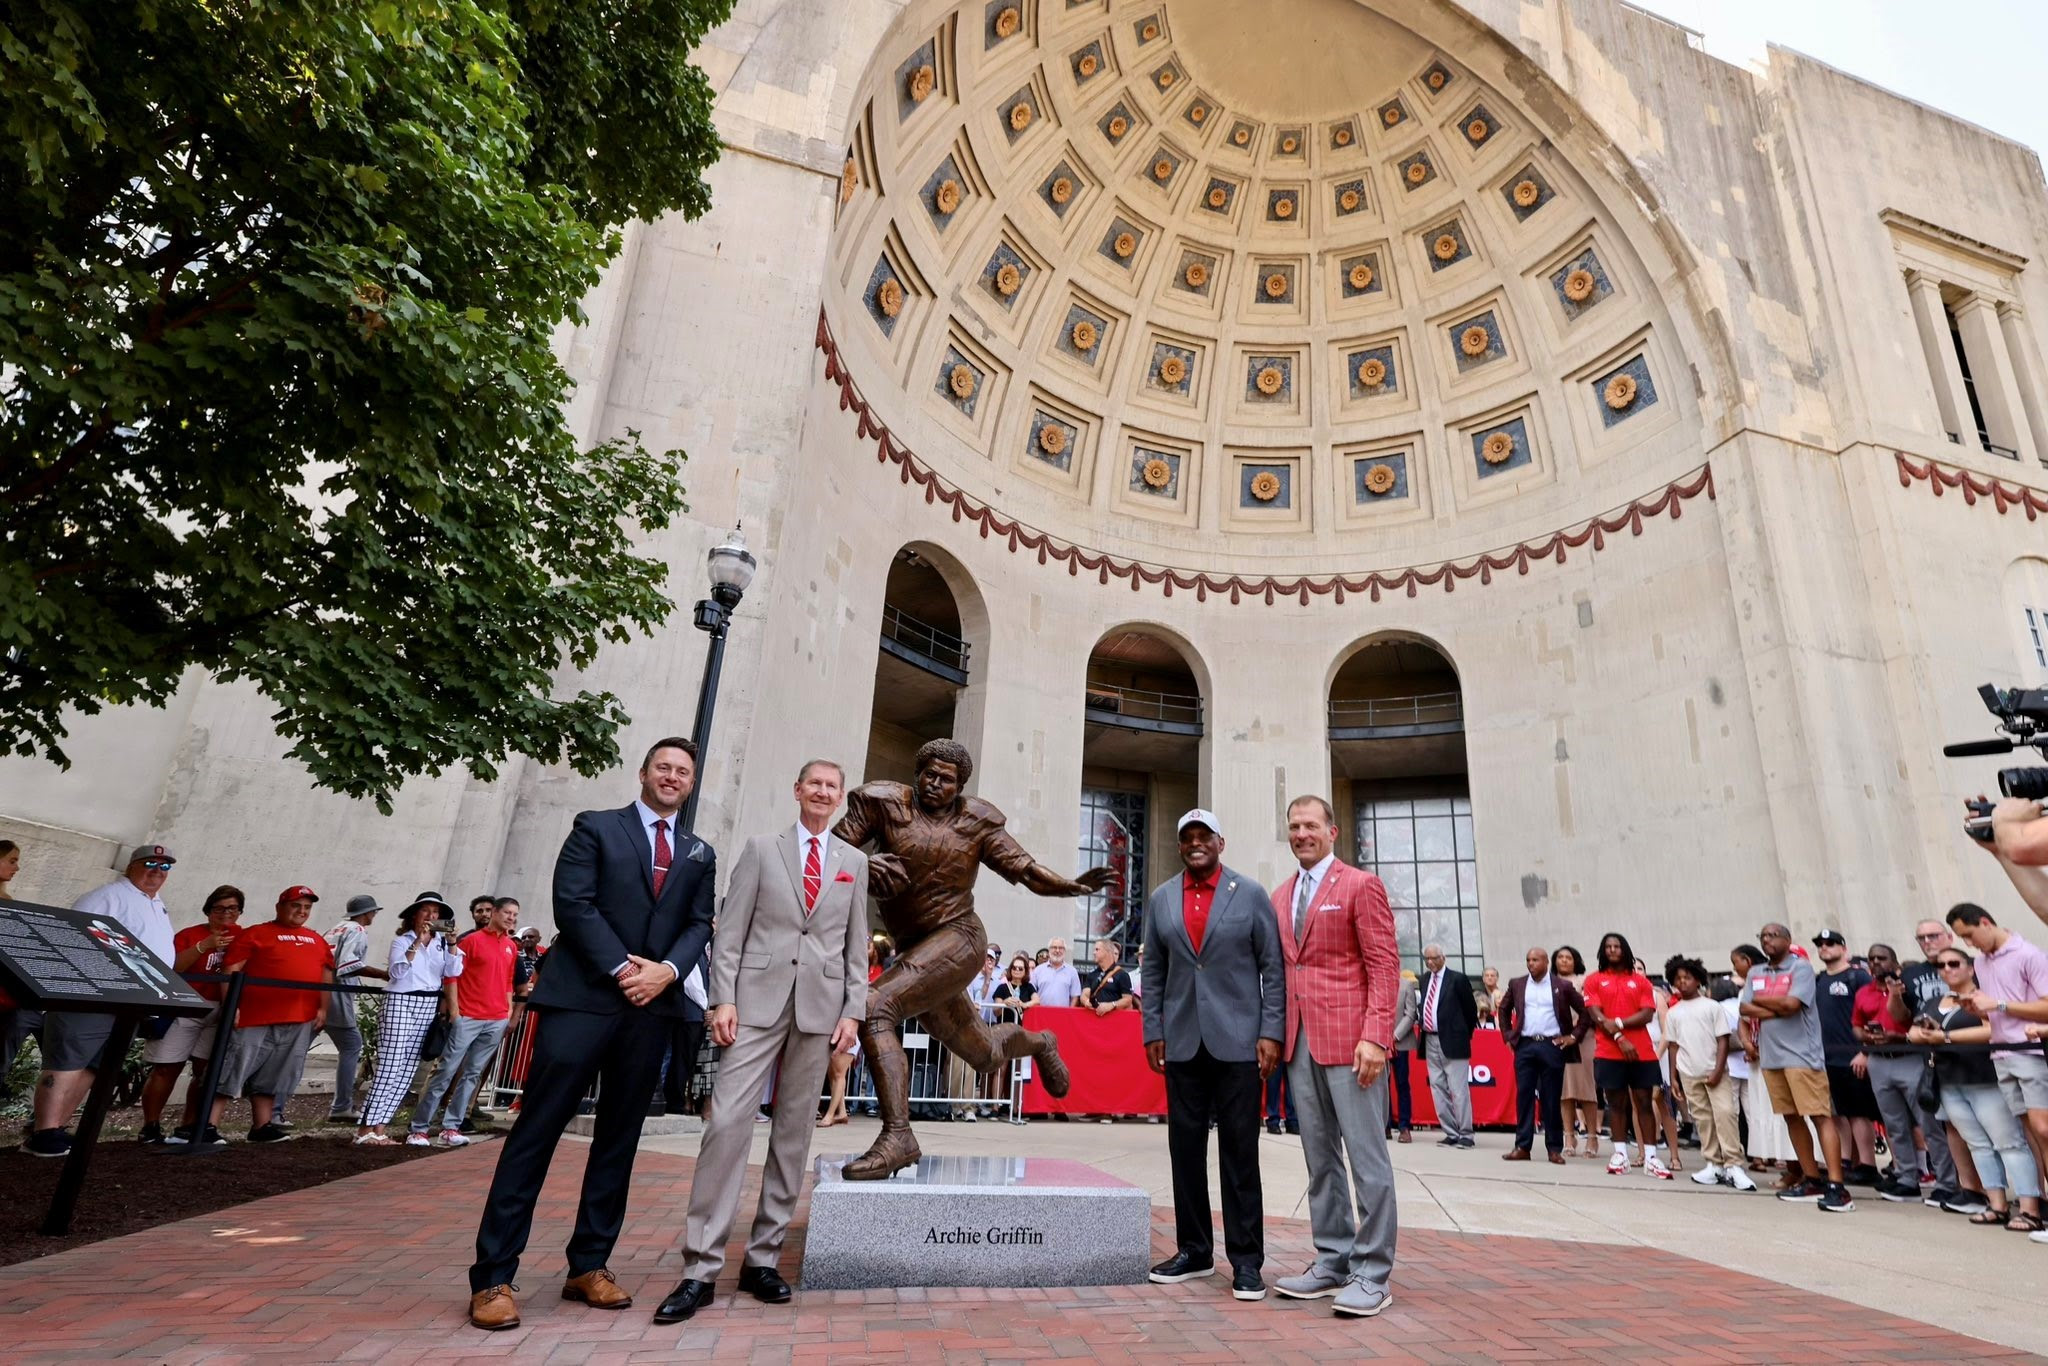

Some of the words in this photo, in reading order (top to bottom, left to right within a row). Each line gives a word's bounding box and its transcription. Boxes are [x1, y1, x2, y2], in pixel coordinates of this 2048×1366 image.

[277, 934, 296, 942] OHIO
[296, 935, 315, 945] STATE
[924, 1226, 981, 1244] Archie
[986, 1226, 1043, 1244] Griffin
